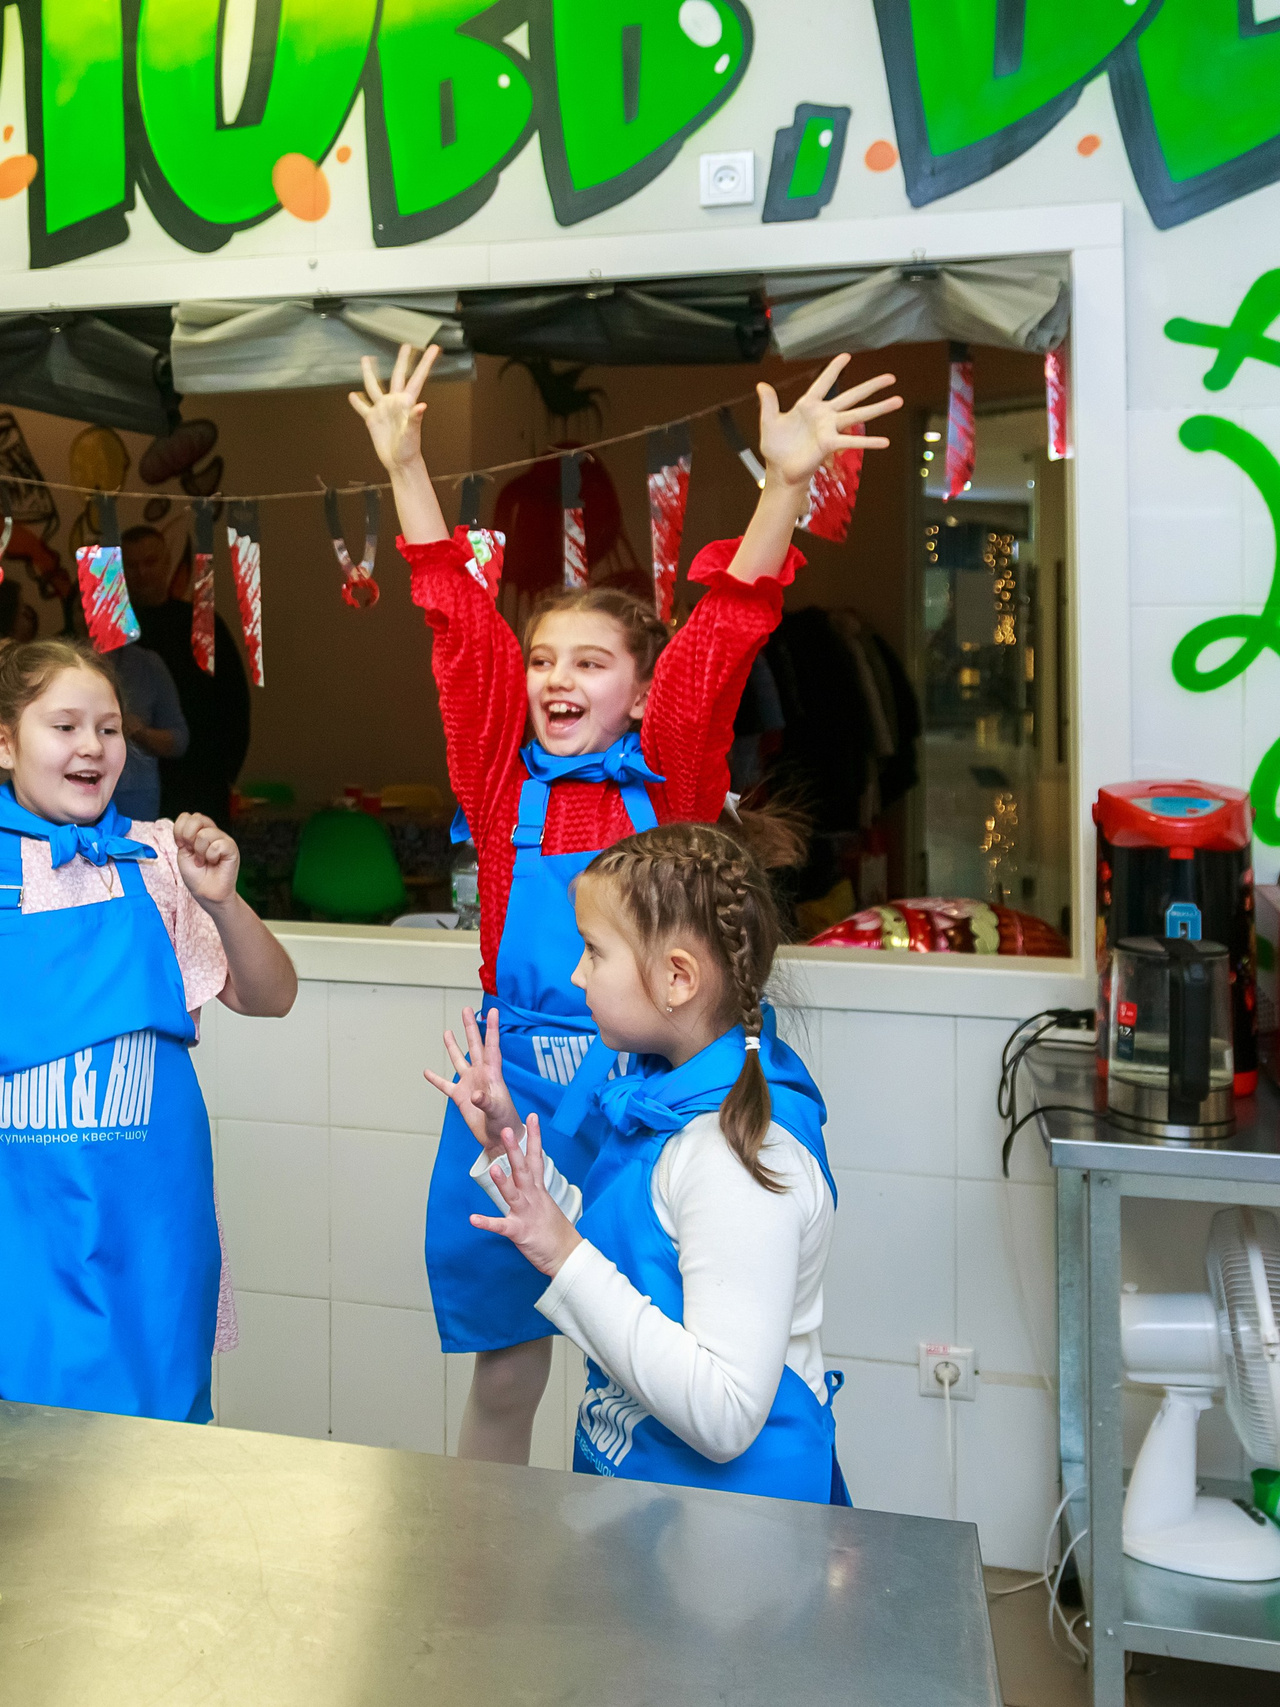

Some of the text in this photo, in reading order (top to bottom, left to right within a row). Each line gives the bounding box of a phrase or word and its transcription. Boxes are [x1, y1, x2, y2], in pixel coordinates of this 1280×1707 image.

[72, 1047, 98, 1129] &
[100, 1030, 157, 1128] RUN
[82, 1129, 148, 1143] квест-шоу
